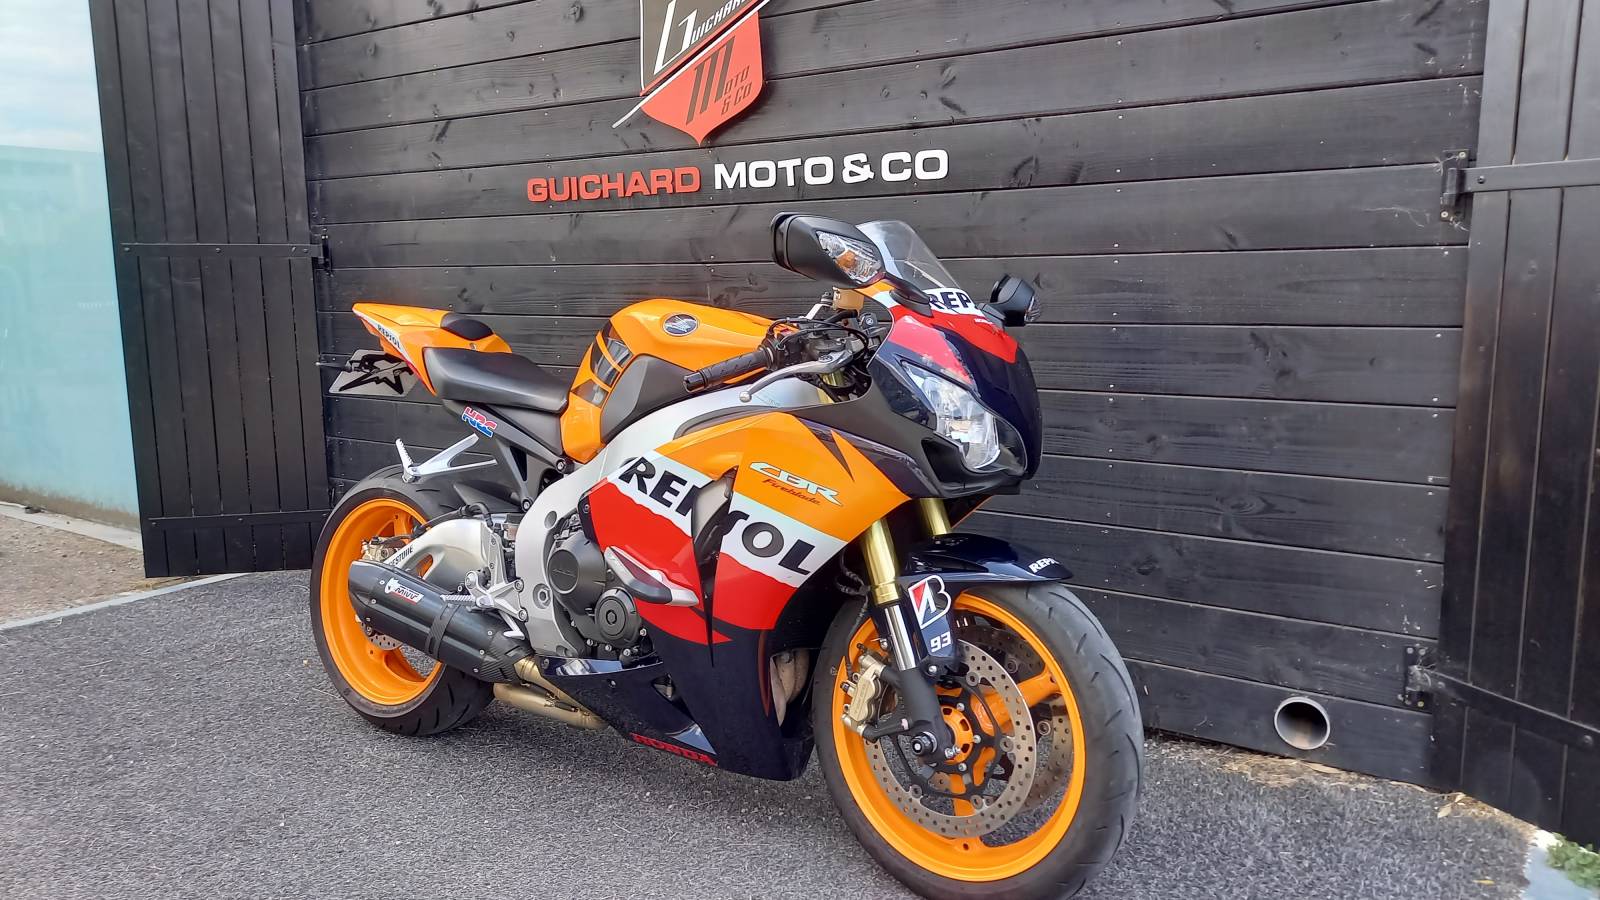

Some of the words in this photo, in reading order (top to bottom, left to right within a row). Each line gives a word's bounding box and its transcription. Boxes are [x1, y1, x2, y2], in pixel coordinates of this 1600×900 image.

[653, 0, 746, 75] GUICHAR
[526, 165, 701, 202] GUICHARD
[461, 406, 497, 438] HRC
[749, 462, 844, 507] CBR
[930, 631, 951, 652] 93
